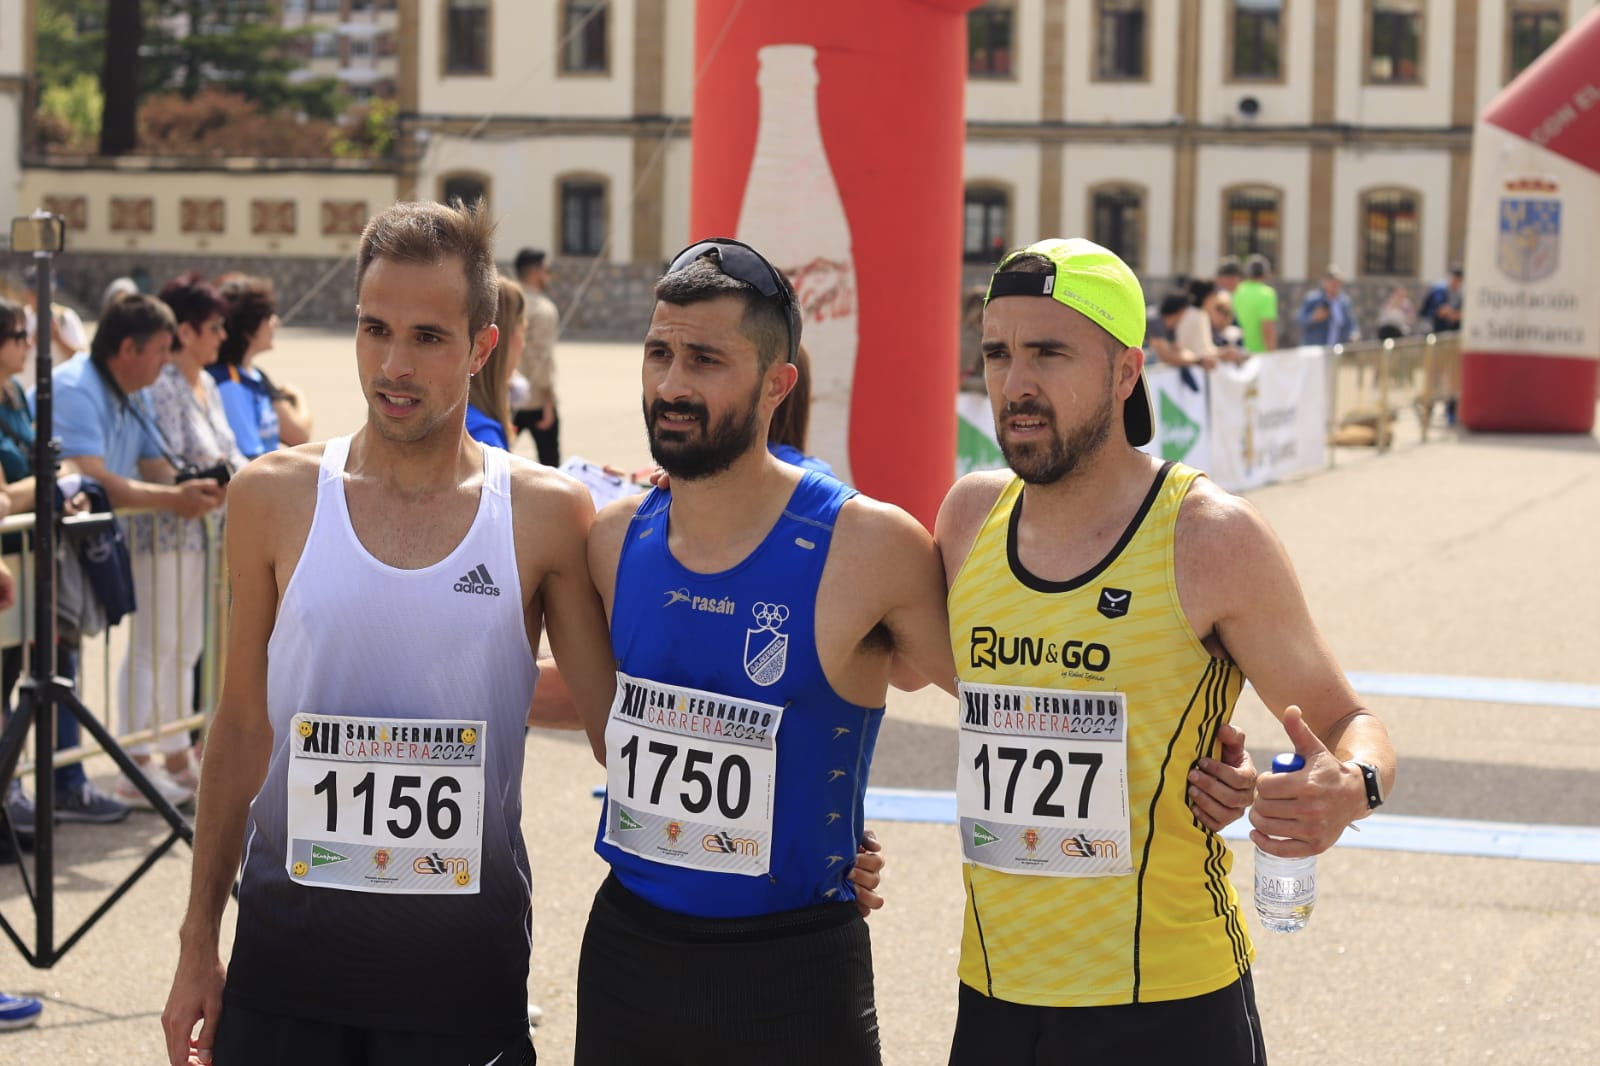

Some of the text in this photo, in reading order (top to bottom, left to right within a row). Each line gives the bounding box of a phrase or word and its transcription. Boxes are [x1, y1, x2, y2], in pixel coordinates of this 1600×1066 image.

[453, 581, 501, 597] adidas
[692, 596, 735, 615] rasán
[620, 683, 772, 728] XII SAN FERNANDO
[964, 691, 1118, 726] XII SAN FERNANDO
[993, 711, 1117, 734] CARRERA 2024
[346, 724, 376, 741] SAN
[392, 727, 476, 744] FERNAND
[648, 706, 767, 742] CARRERA 2024
[345, 741, 476, 760] CARRERA 2024
[621, 735, 751, 820] 1750
[974, 744, 1103, 819] 1727
[314, 771, 462, 840] 1156
